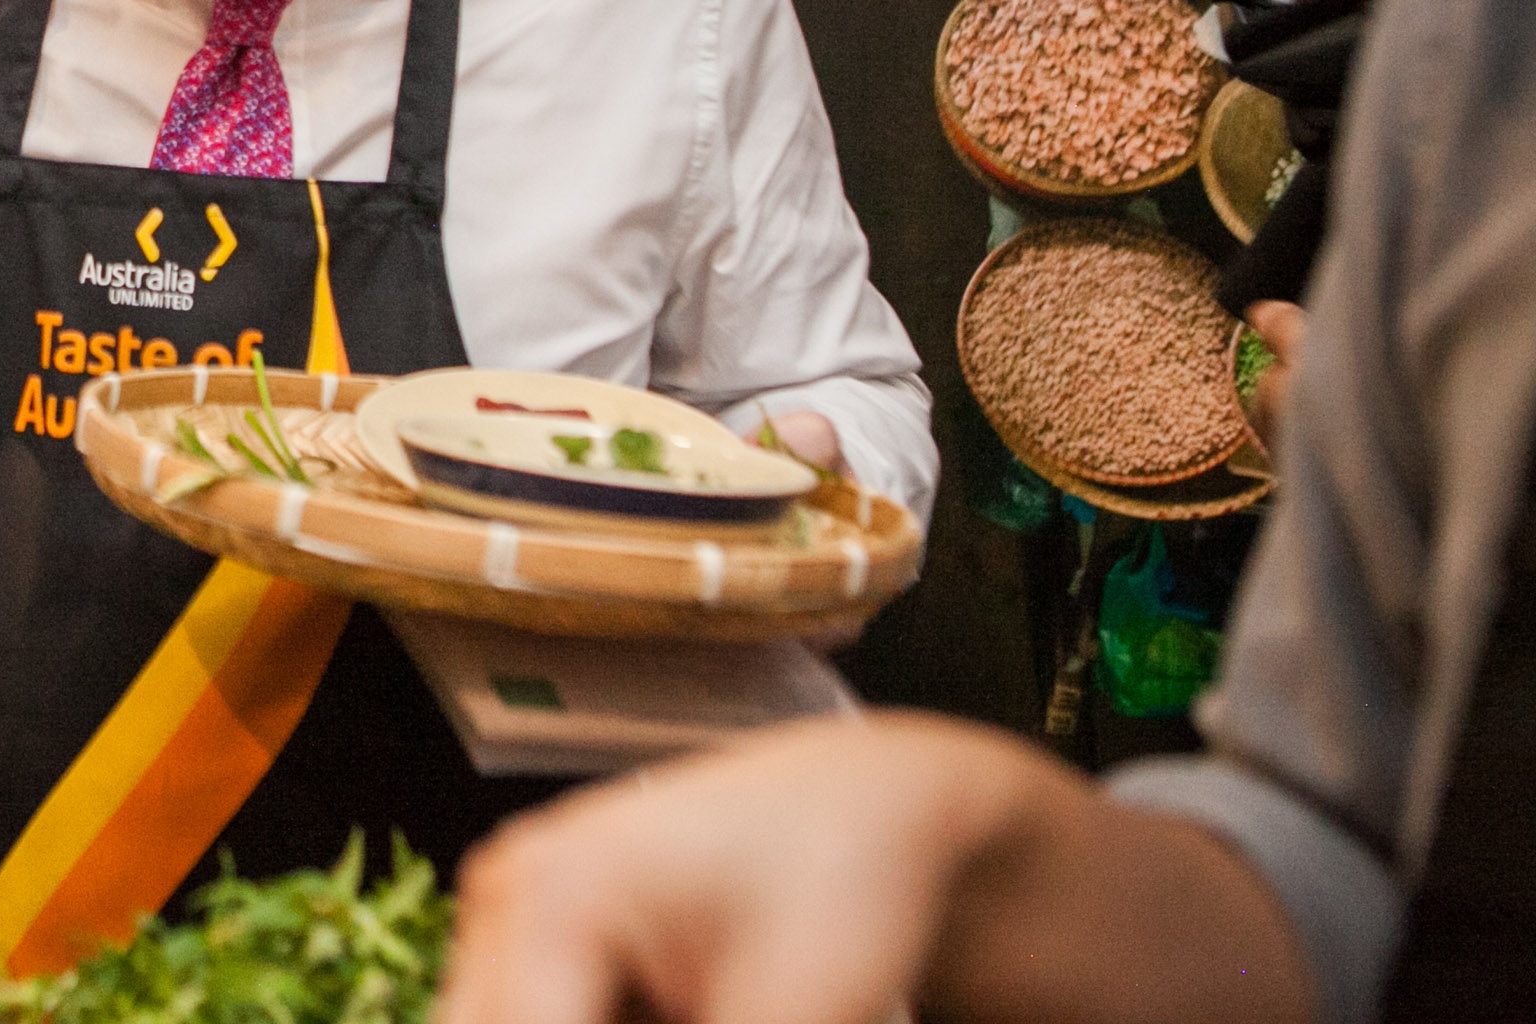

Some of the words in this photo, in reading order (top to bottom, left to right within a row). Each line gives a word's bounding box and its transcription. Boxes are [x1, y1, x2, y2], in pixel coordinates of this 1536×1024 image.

[79, 252, 196, 294] Australia
[108, 287, 194, 311] UNLIMITED
[35, 310, 178, 376] Taste
[193, 328, 264, 368] of
[14, 374, 78, 439] Au
